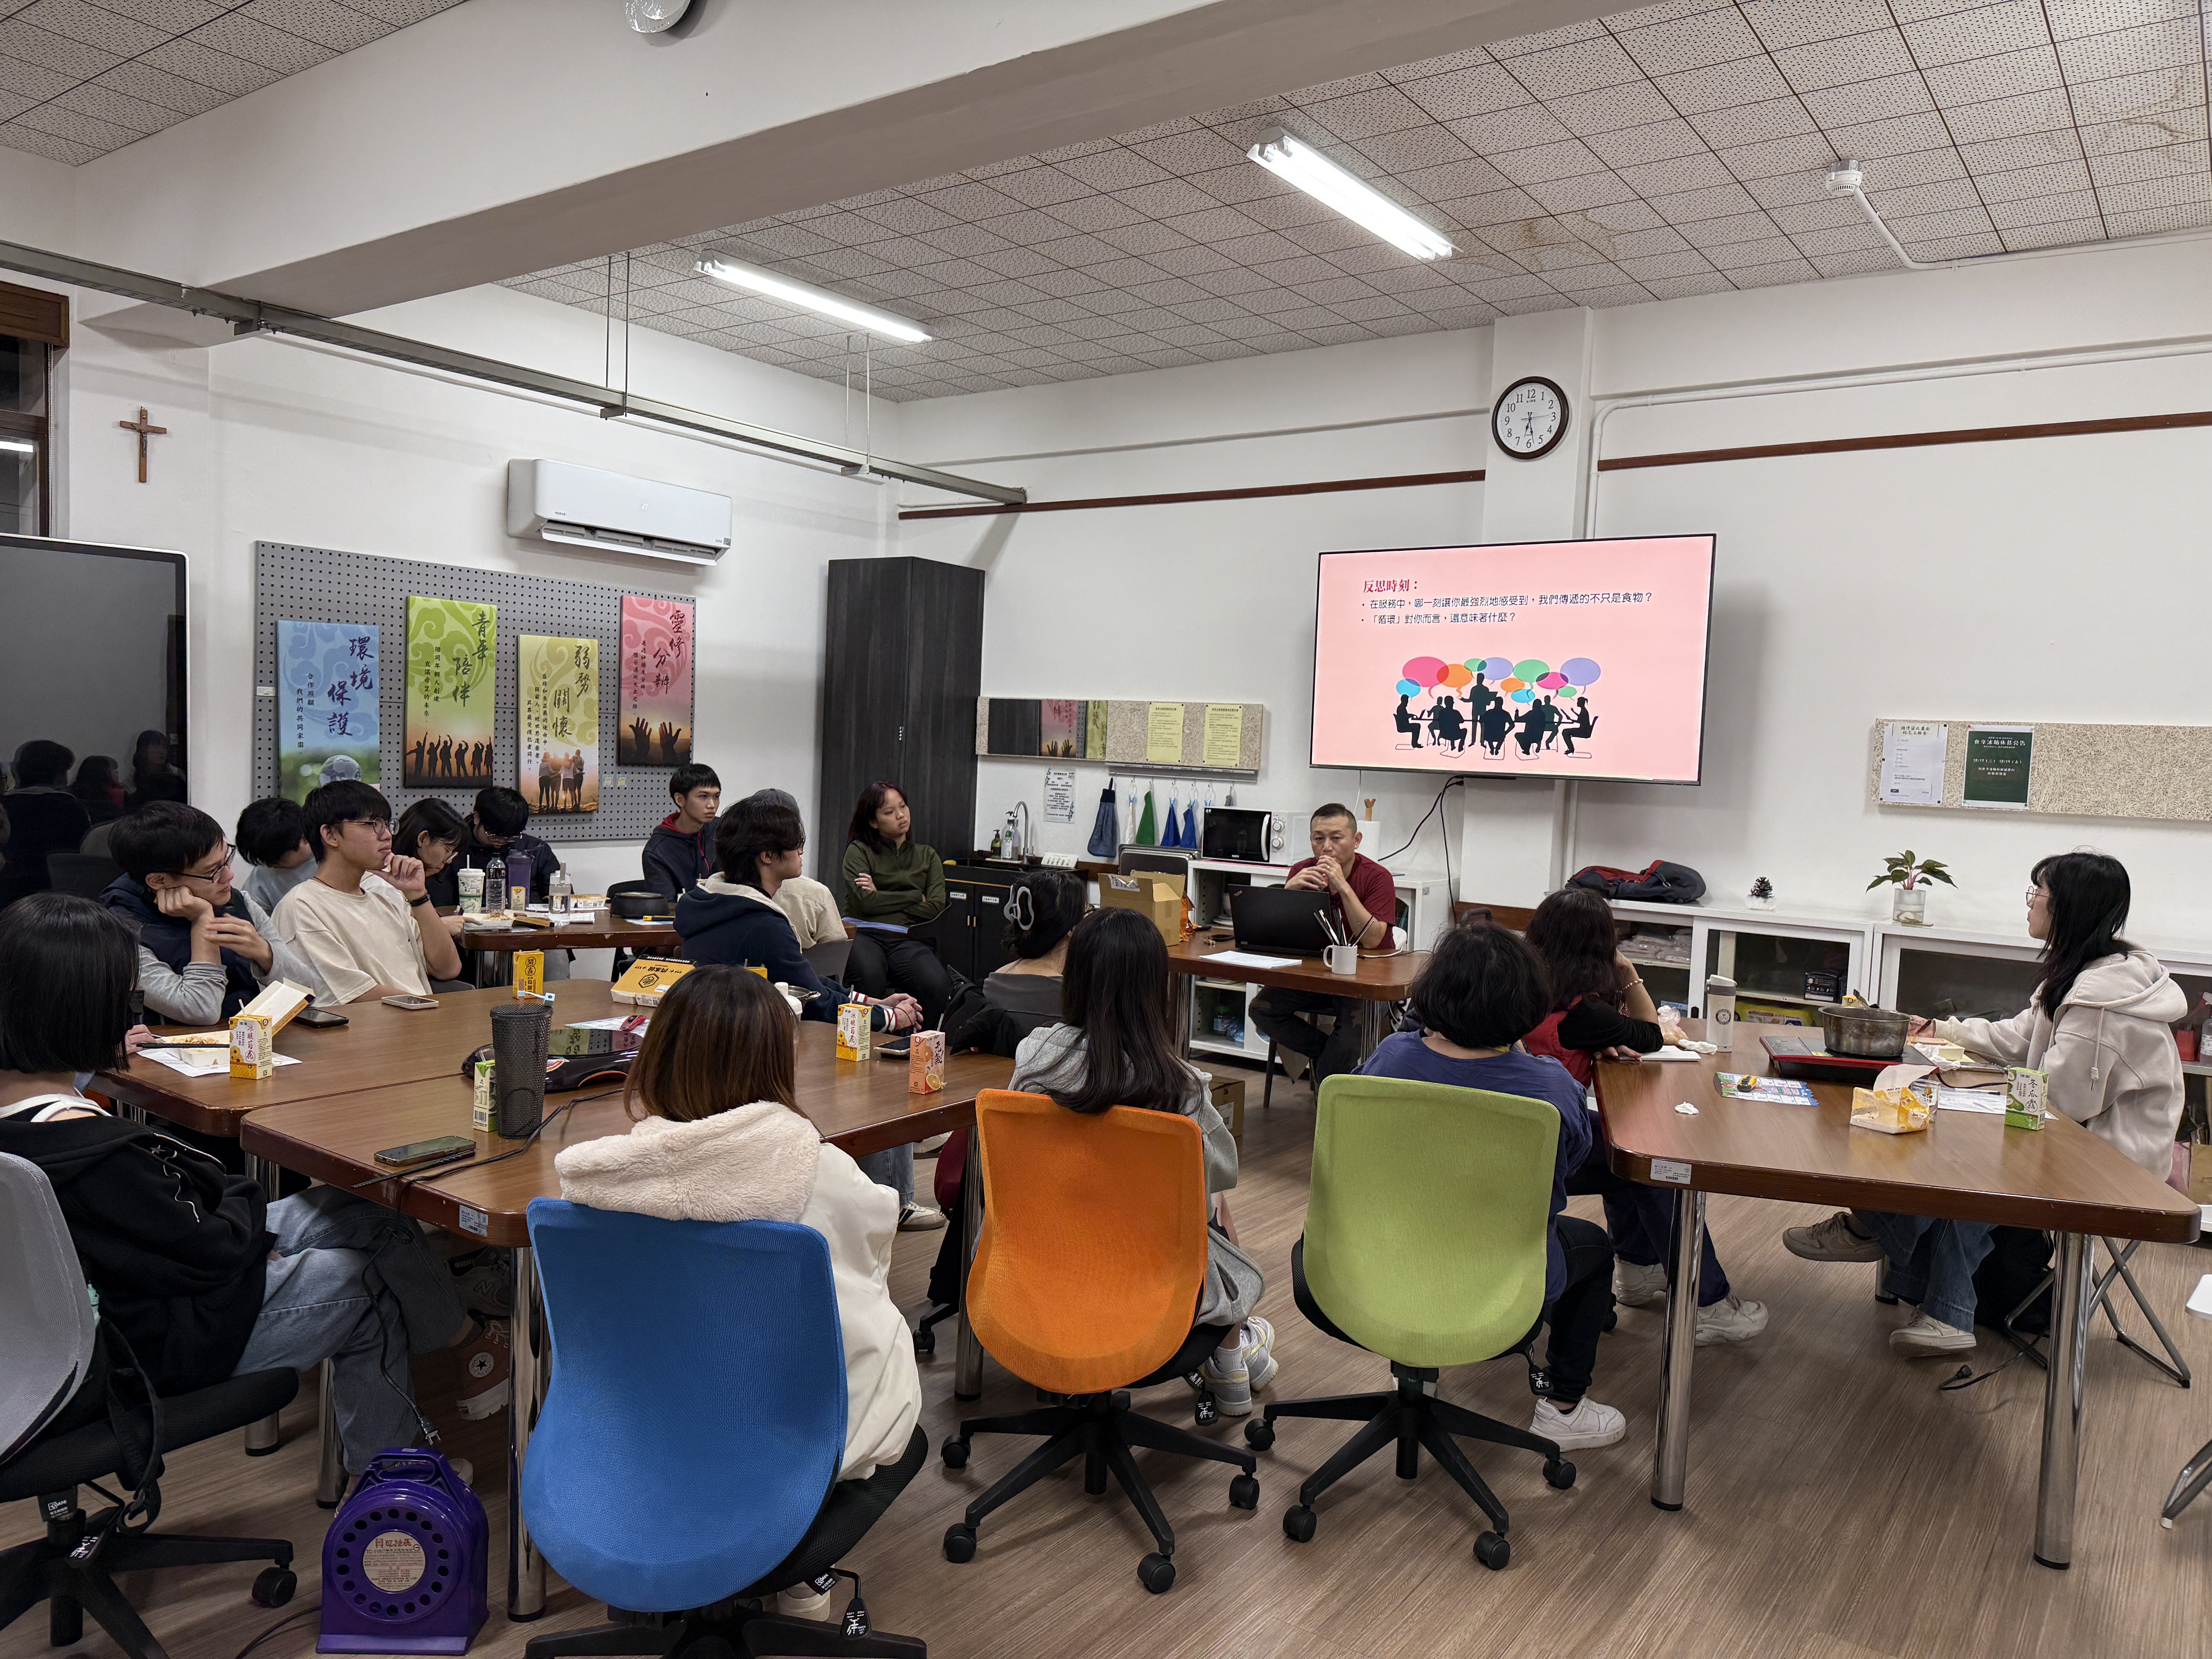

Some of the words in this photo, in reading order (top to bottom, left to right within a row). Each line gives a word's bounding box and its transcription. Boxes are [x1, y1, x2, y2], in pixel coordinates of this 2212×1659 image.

[1516, 393, 1523, 403] 11
[1527, 389, 1536, 398] 12
[1541, 392, 1544, 400] 1
[1507, 403, 1516, 412] 10
[1548, 400, 1553, 409] 2
[1505, 416, 1510, 425] 9
[1551, 412, 1556, 421] 3
[1507, 428, 1512, 437] 8
[1547, 425, 1552, 434] 4
[1515, 437, 1520, 446] 7
[1526, 439, 1531, 448] 6
[1538, 435, 1543, 444] 5
[1363, 579, 1418, 593] 反思時刻：
[349, 636, 374, 690] 環境
[575, 645, 591, 697] 弱勢
[327, 681, 353, 736] 保護
[553, 687, 572, 738] 關懷
[2028, 1078, 2038, 1109] 冬瓜露
